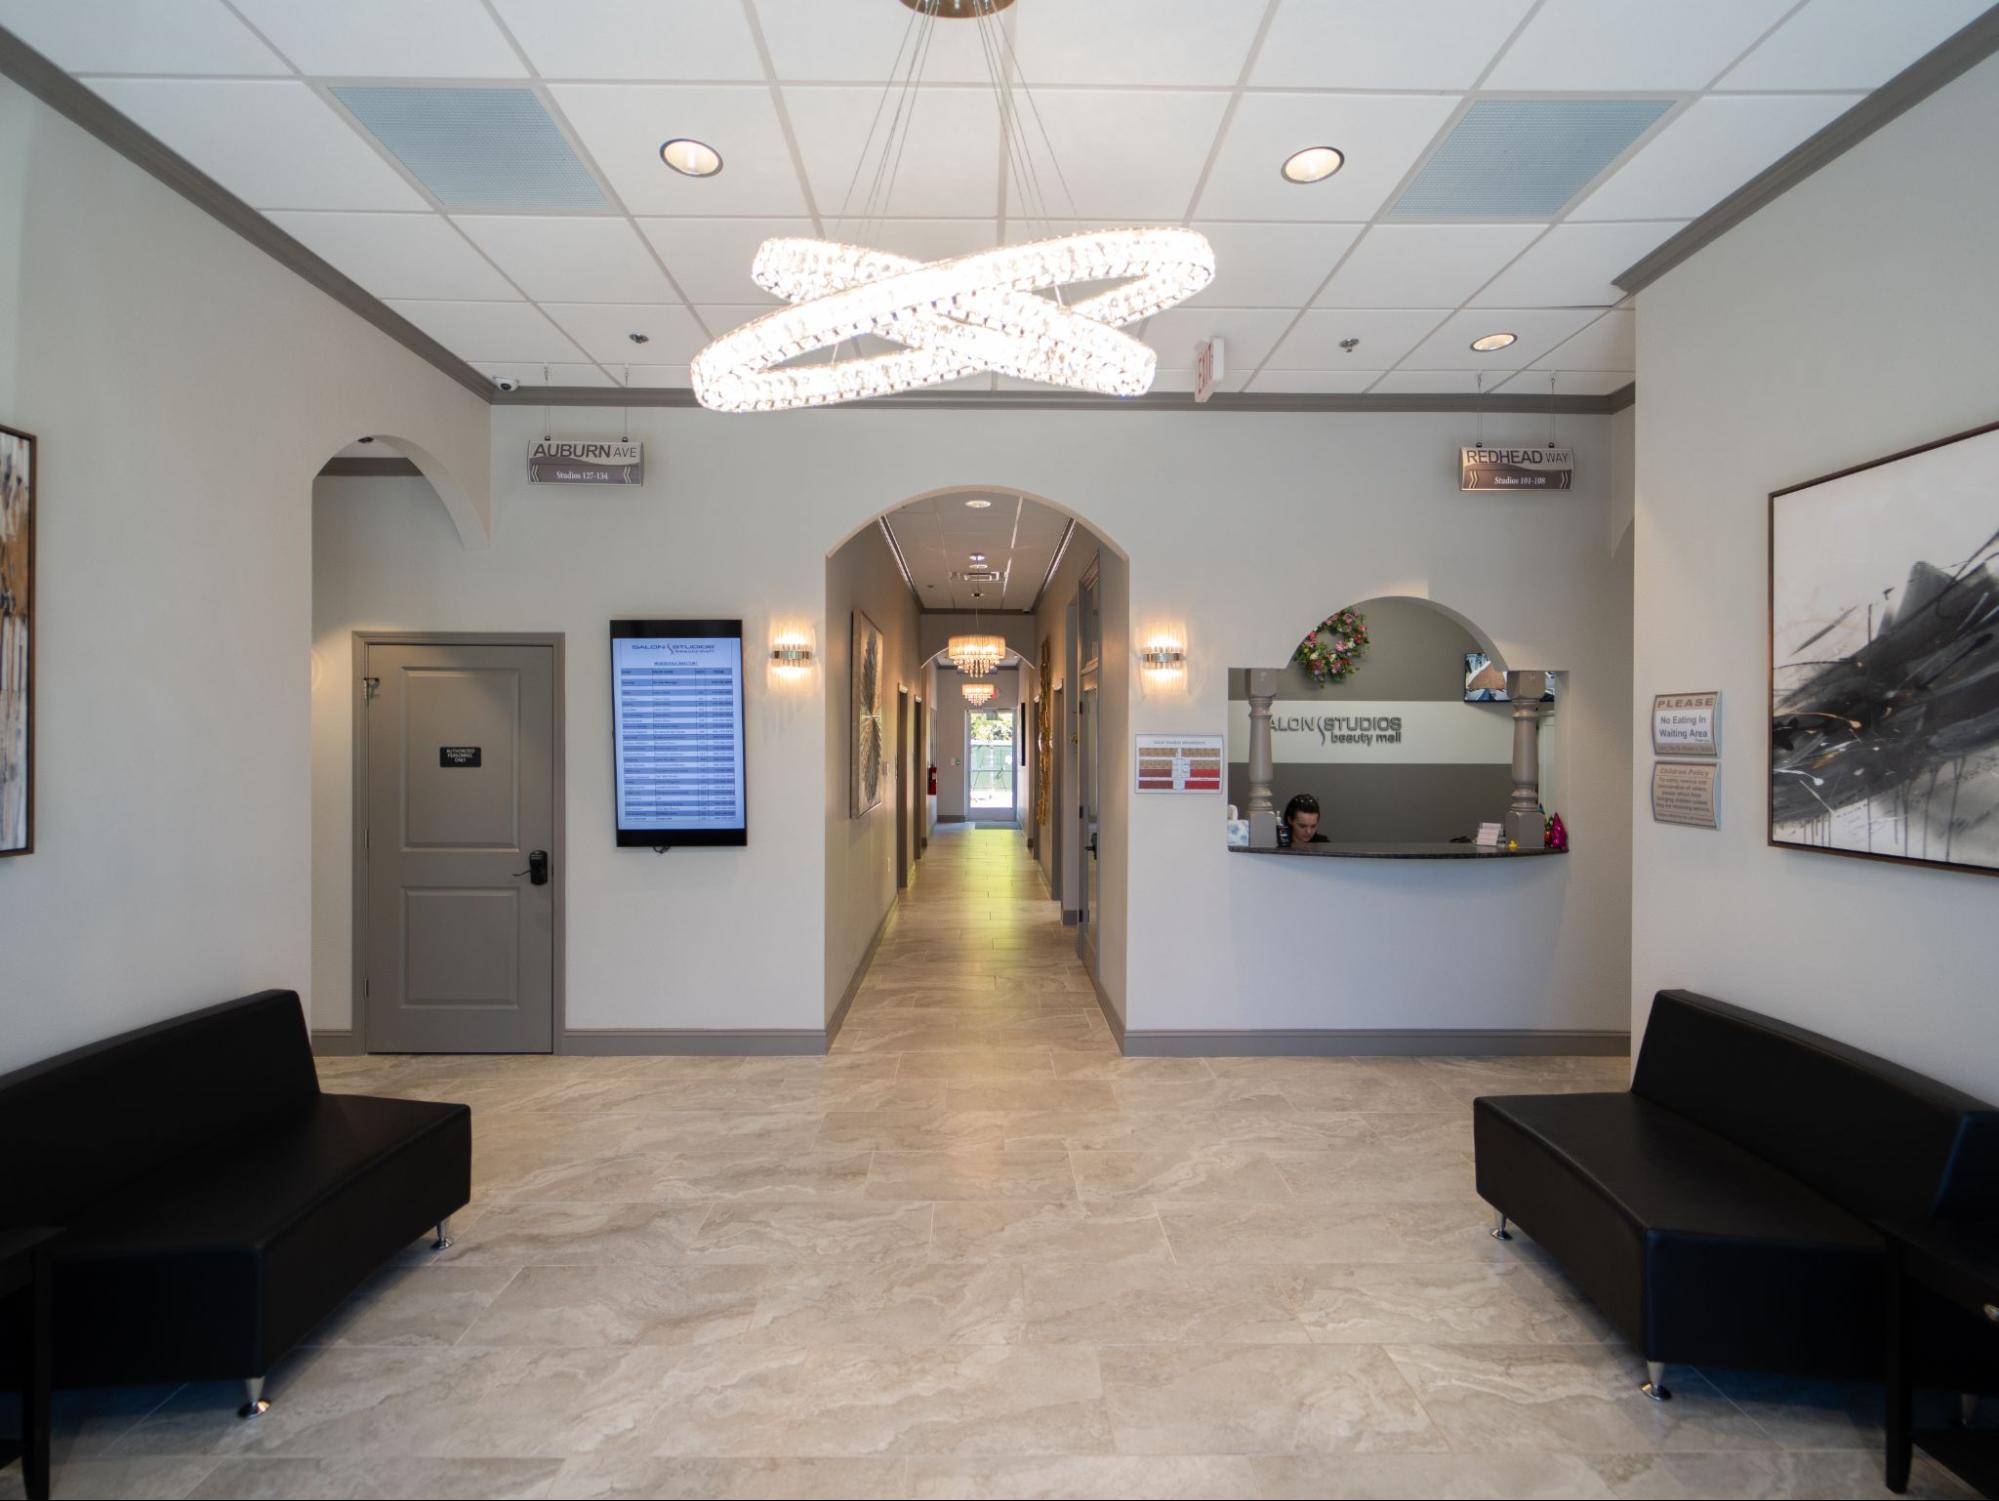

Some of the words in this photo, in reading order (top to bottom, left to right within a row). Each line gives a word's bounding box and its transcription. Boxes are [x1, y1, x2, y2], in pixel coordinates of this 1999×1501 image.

[533, 443, 611, 459] AUBURN
[613, 447, 637, 458] AVE
[1466, 450, 1543, 464] REDHEAD
[1545, 452, 1568, 463] WAY
[556, 471, 581, 480] Studios
[1494, 476, 1519, 485] Studios
[1657, 697, 1713, 709] PLEASE
[1323, 716, 1402, 732] STUDIOS
[1660, 715, 1671, 724] No
[1672, 715, 1697, 725] Eating
[1330, 732, 1373, 746] beauty
[1375, 732, 1402, 744] mall
[1659, 728, 1688, 739] Waiting
[1689, 729, 1708, 738] Area
